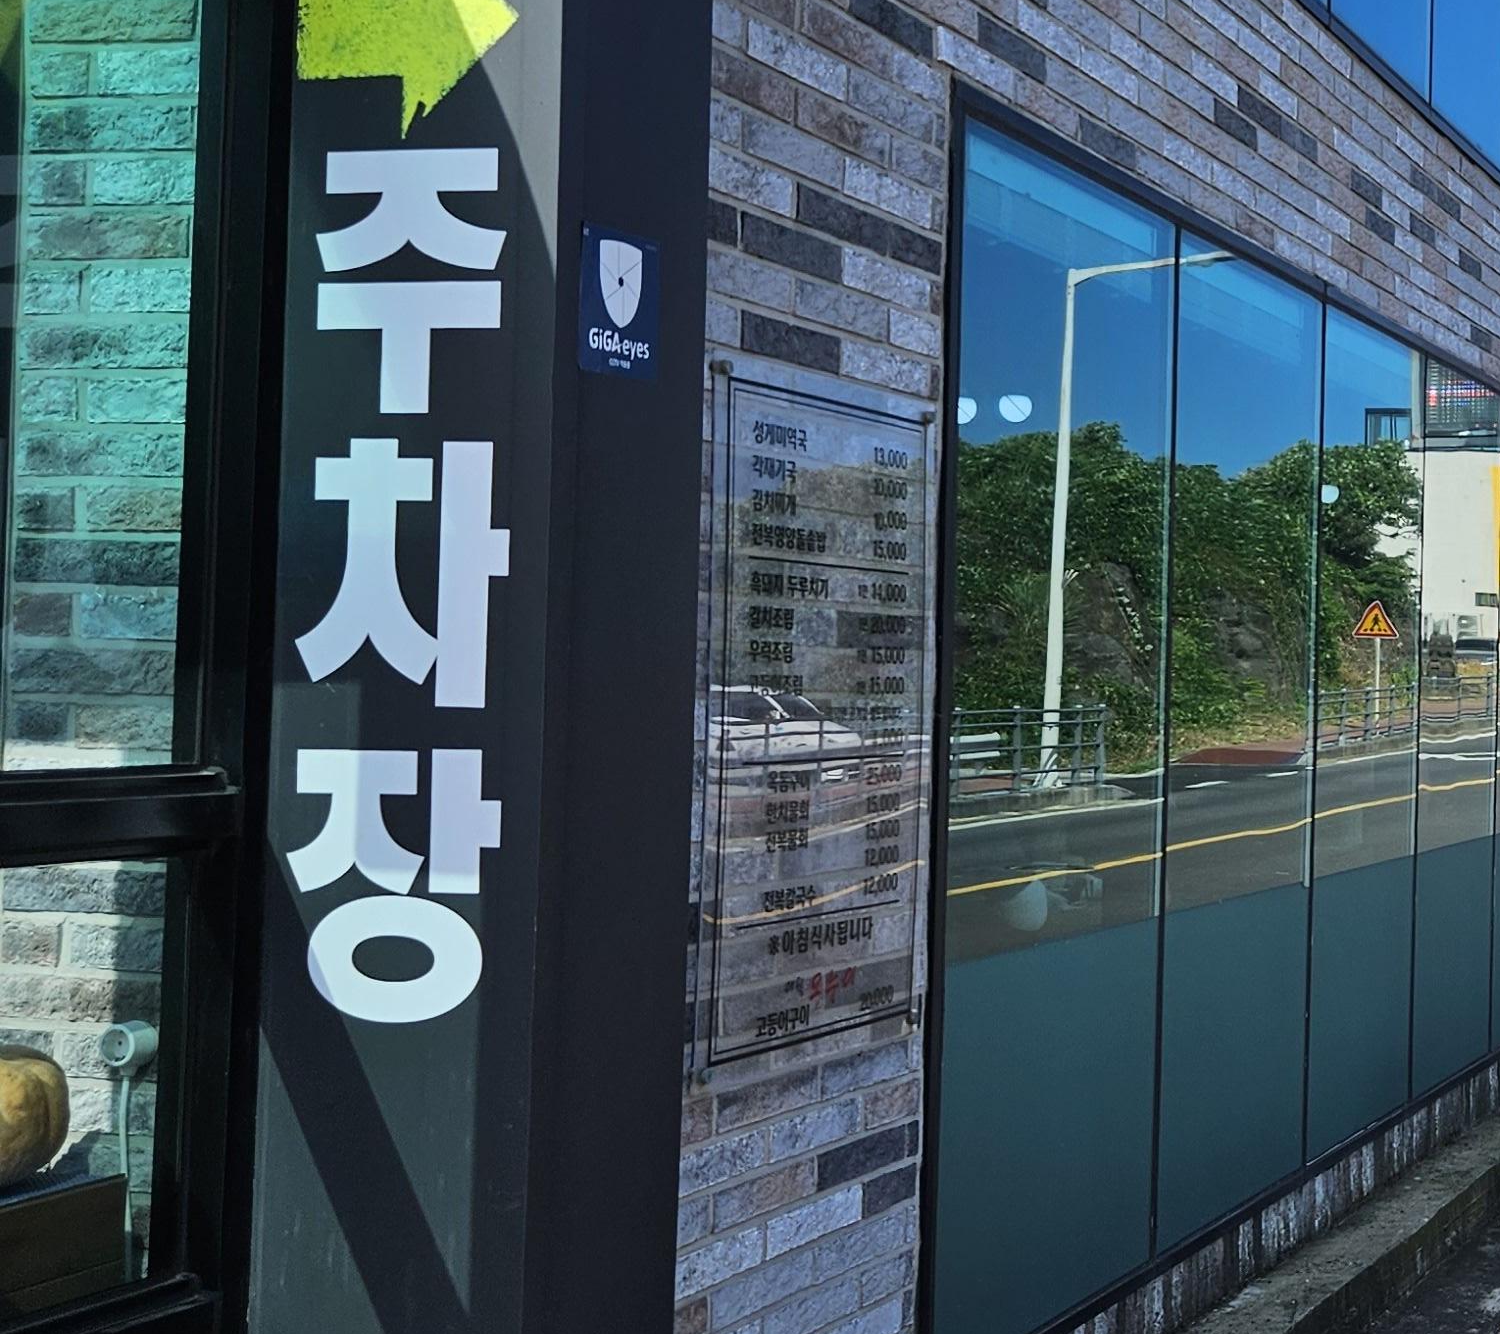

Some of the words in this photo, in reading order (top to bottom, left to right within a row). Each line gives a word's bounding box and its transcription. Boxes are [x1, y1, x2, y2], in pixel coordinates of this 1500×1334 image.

[752, 419, 808, 452] 성게미역국
[873, 447, 908, 470] 13,000
[872, 541, 907, 561] 15,000
[286, 147, 512, 1024] 주차장
[787, 573, 830, 600] 두루치기
[871, 646, 906, 665] 15,000
[864, 844, 900, 867] 12,000
